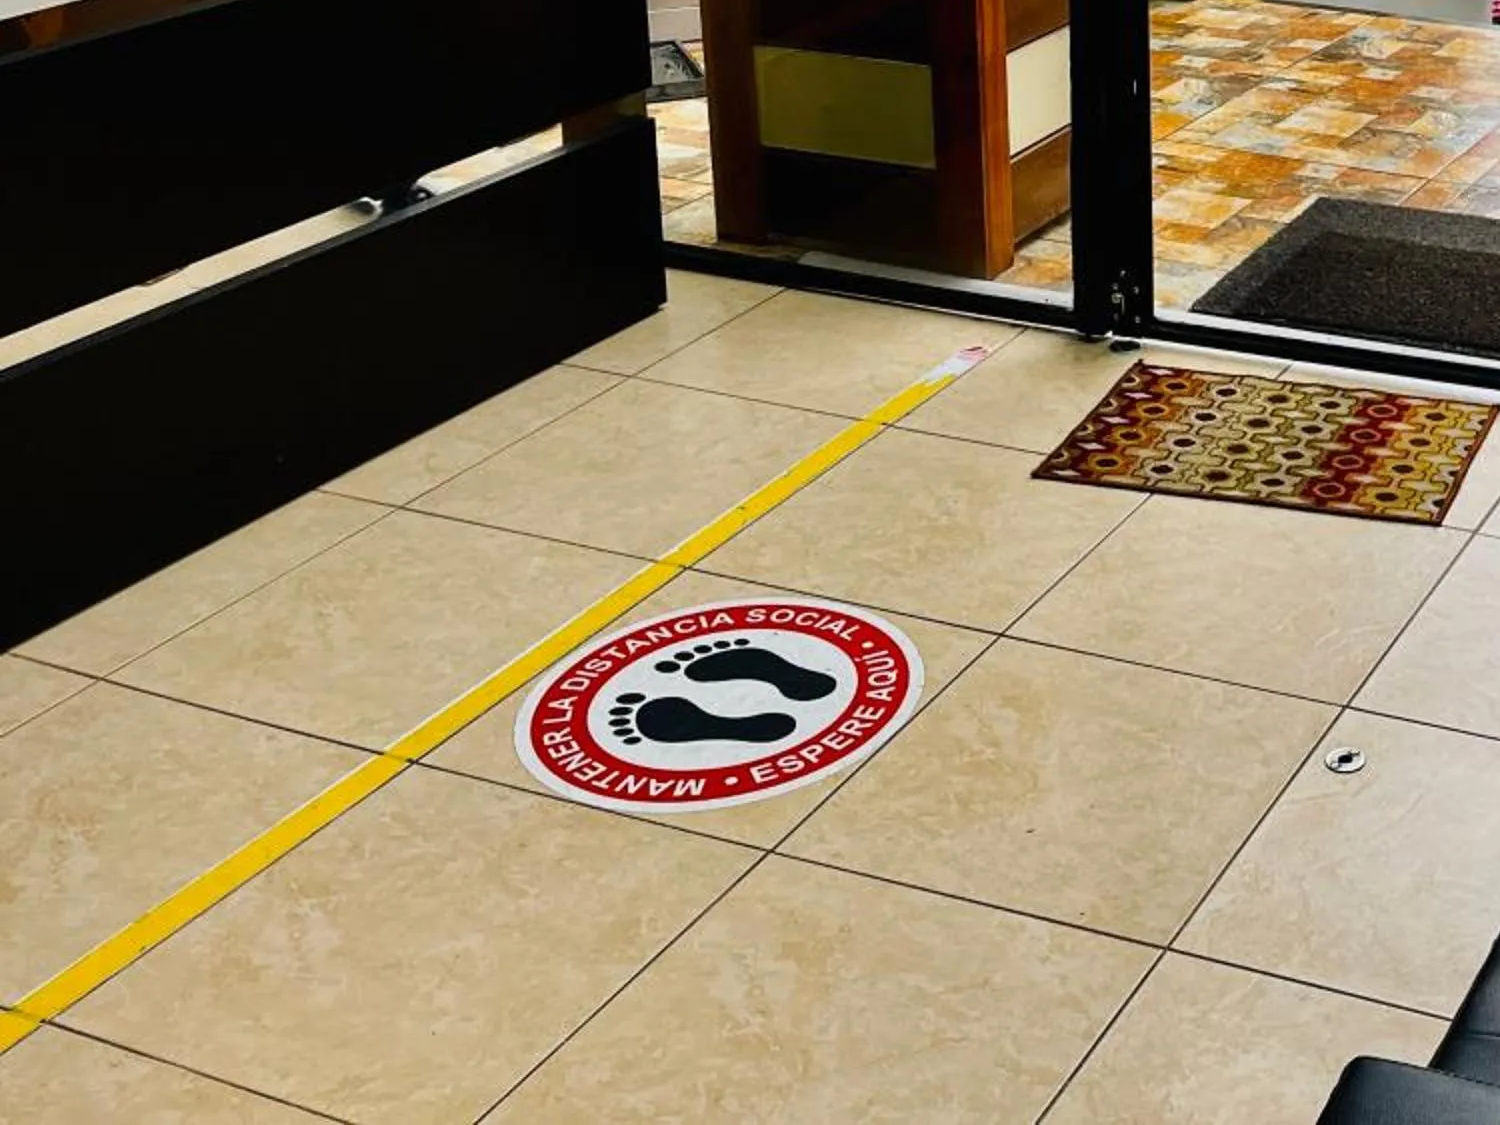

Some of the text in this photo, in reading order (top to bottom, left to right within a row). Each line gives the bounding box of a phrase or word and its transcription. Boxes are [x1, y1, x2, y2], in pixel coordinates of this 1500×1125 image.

[544, 608, 854, 797] MANTENER LA DISTANCIA SOCIAL
[750, 705, 885, 784] ESPERE
